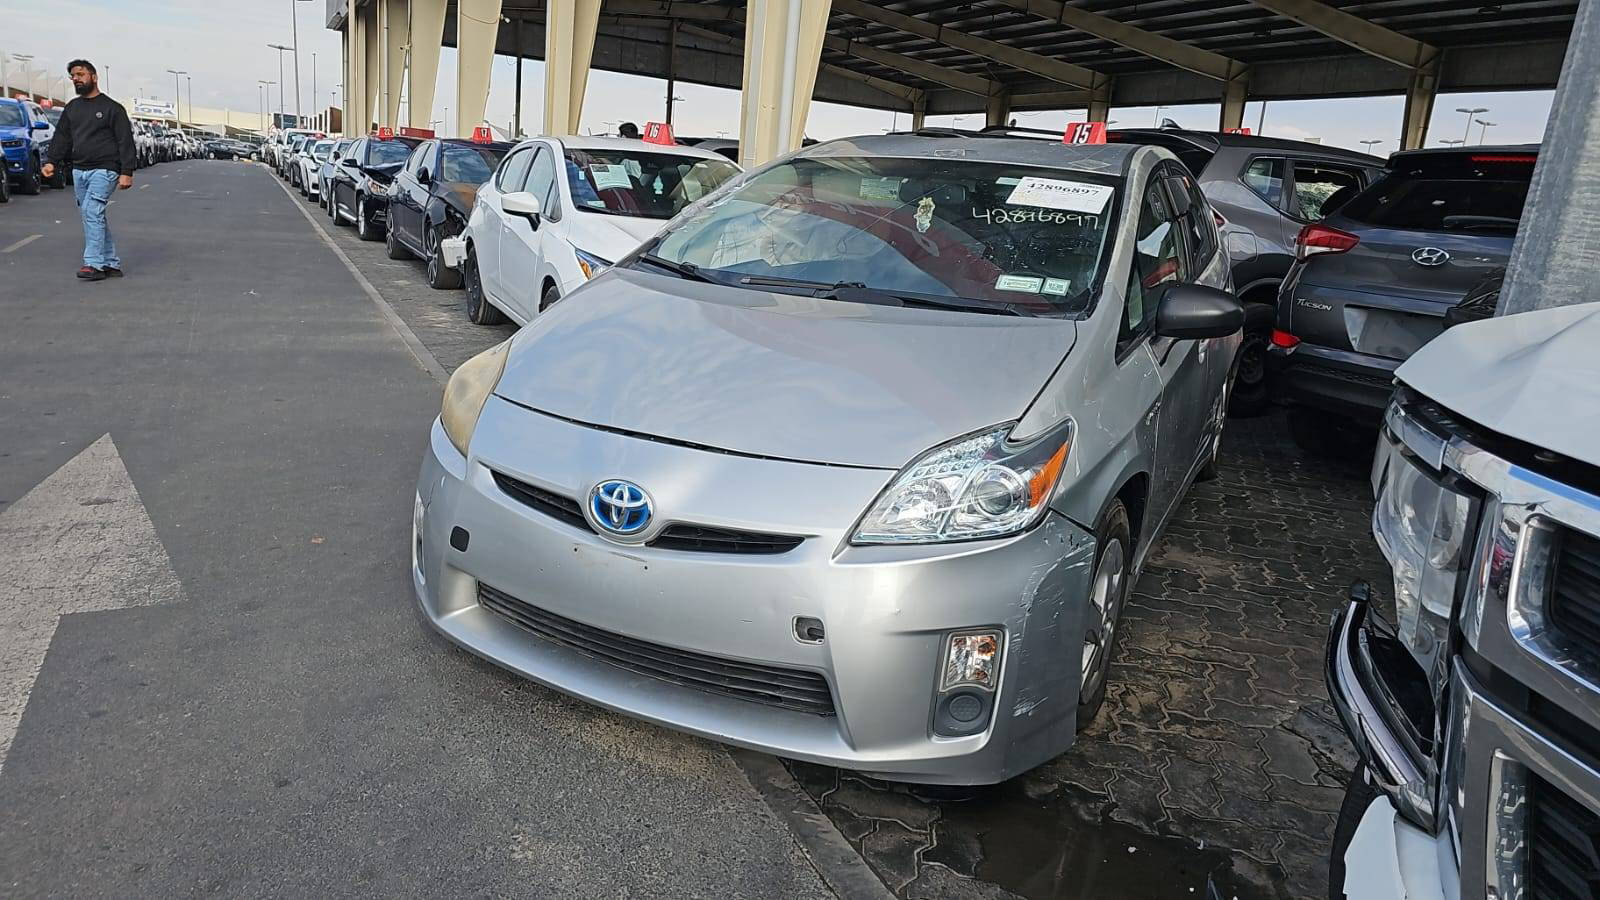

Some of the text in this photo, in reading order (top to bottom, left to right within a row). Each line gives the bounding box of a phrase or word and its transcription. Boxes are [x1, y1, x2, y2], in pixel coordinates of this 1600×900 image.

[649, 124, 660, 138] 16
[1072, 124, 1092, 144] 15
[1026, 182, 1100, 196] 42896897
[1297, 298, 1332, 311] TUCSON
